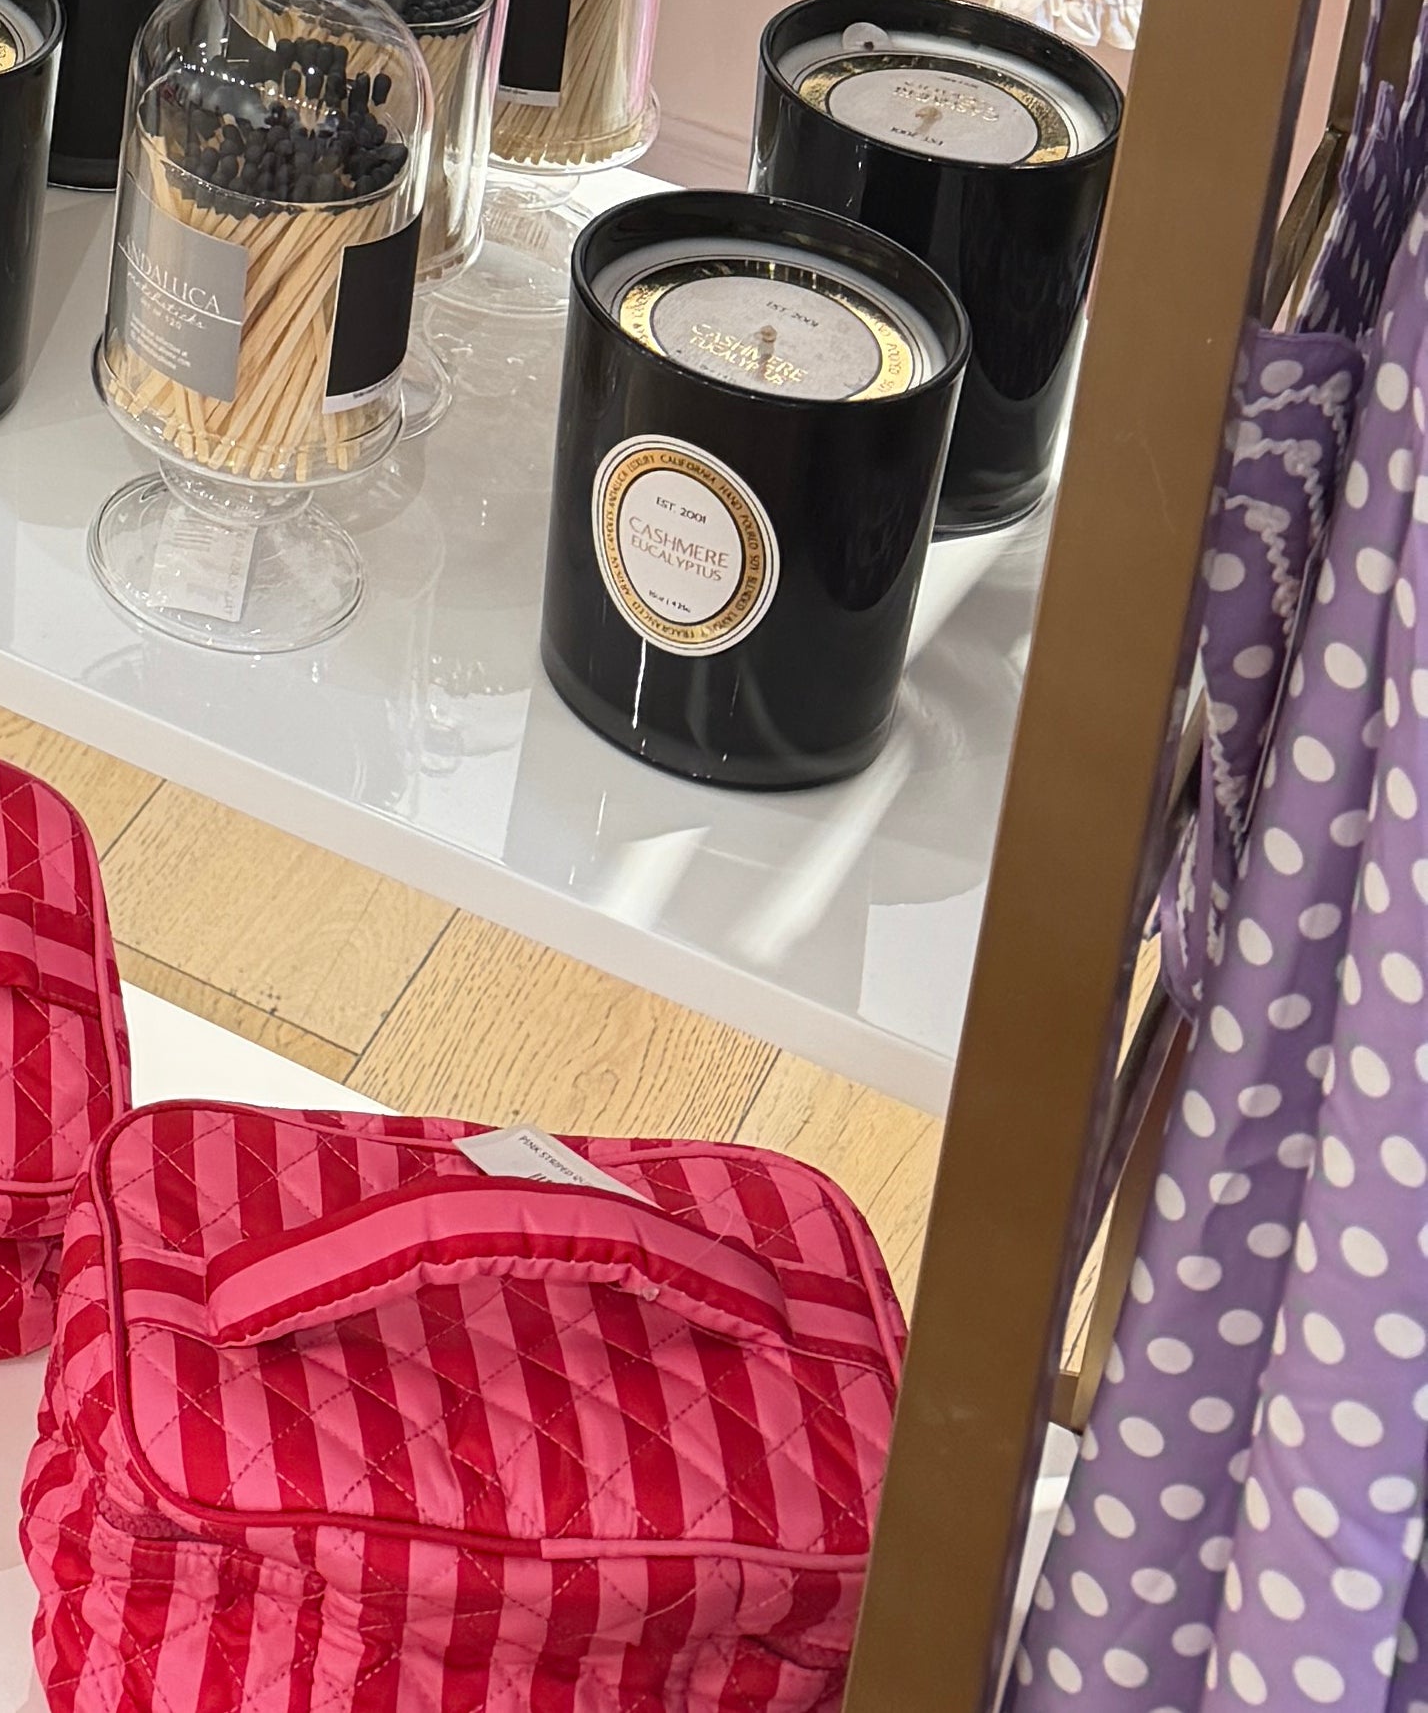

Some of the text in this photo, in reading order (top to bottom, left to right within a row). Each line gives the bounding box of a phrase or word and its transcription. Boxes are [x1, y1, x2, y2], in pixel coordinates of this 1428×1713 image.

[659, 453, 716, 484] CALIFORNIA
[655, 495, 708, 525] EST. 2001
[719, 484, 743, 512] HAND
[628, 515, 730, 570] CASHMERE
[740, 513, 759, 550] POURED
[630, 536, 723, 583] EUCALYPTUS
[748, 554, 761, 572] SOY
[518, 1134, 574, 1178] PINK STRIPED
